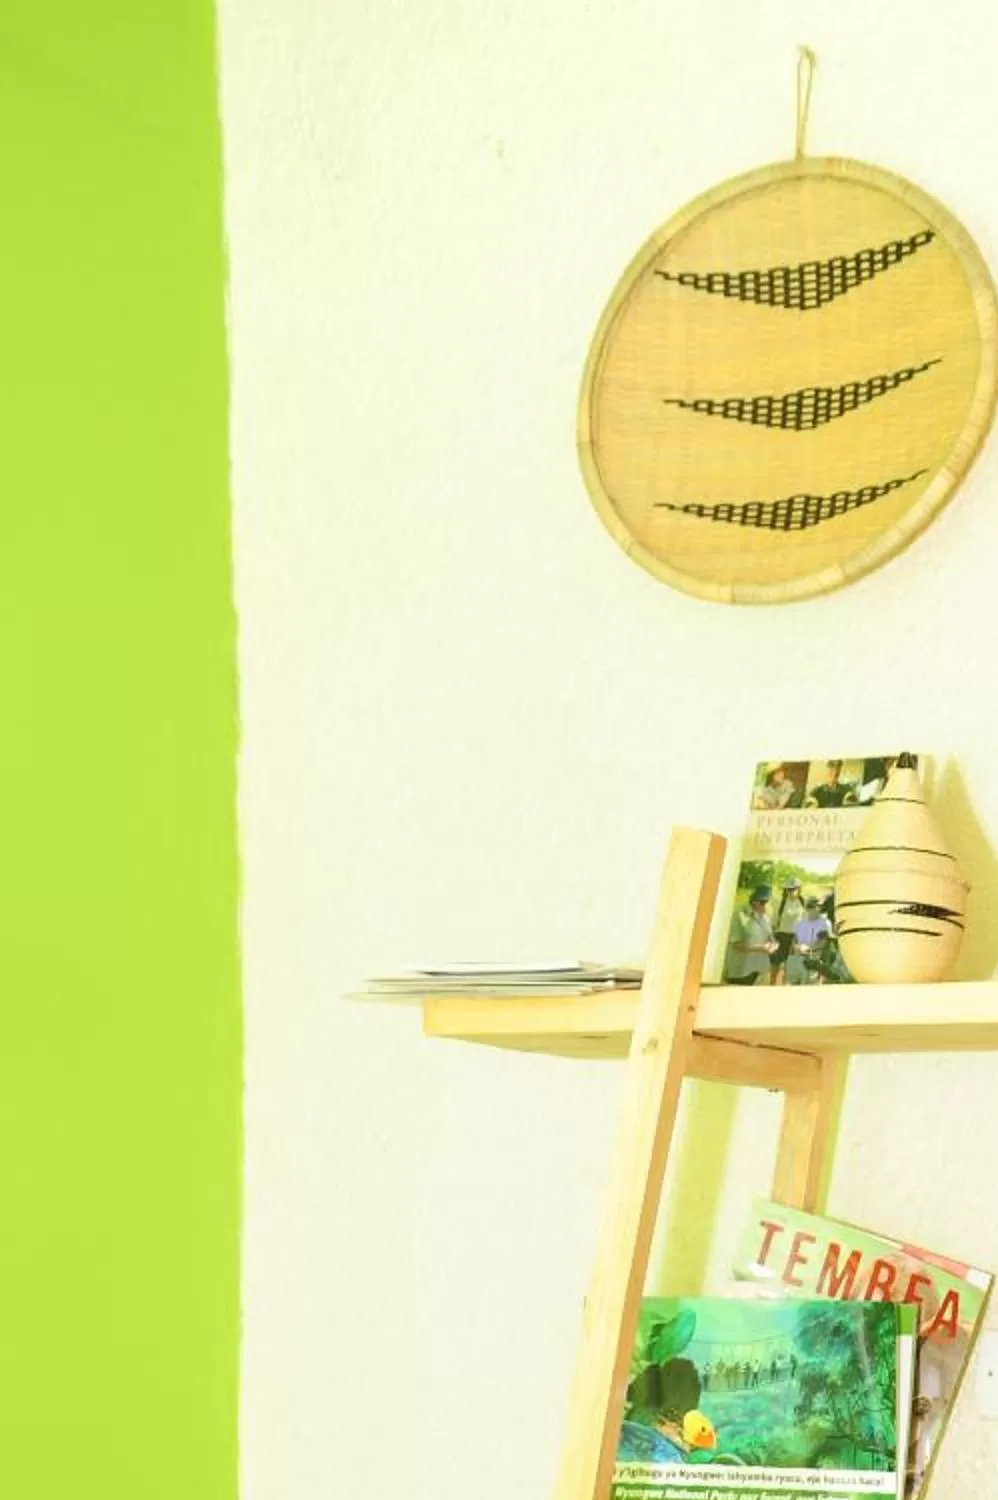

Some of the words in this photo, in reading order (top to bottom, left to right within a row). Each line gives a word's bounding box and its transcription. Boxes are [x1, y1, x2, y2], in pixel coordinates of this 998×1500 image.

[757, 813, 840, 828] PERSONAL
[759, 1219, 961, 1342] TEMBEA
[664, 1487, 710, 1500] National
